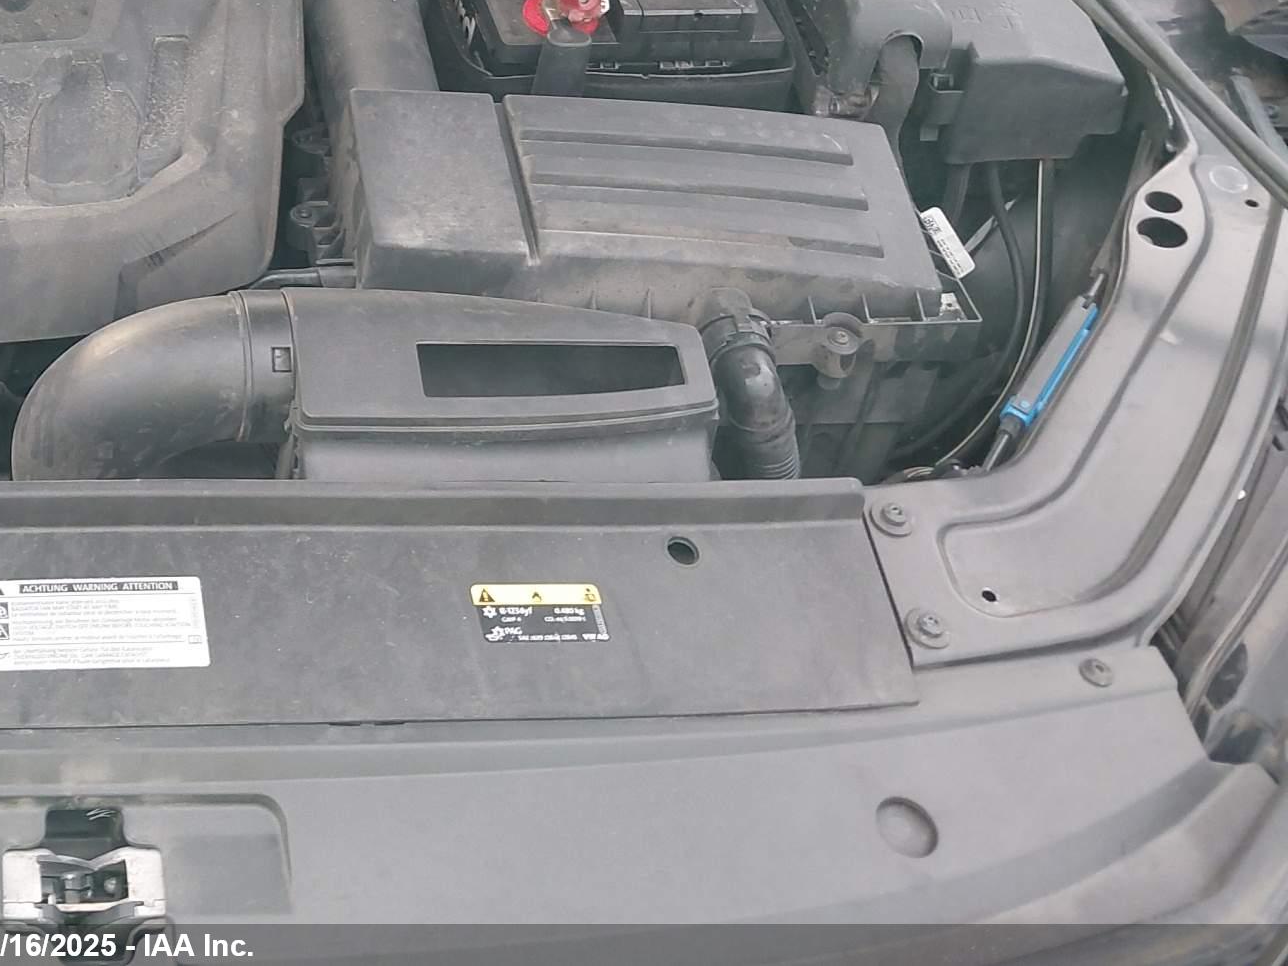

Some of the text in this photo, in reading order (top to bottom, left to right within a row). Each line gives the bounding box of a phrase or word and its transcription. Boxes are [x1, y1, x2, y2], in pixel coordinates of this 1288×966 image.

[22, 581, 173, 593] ACHTUNG WARNING ATTENTION
